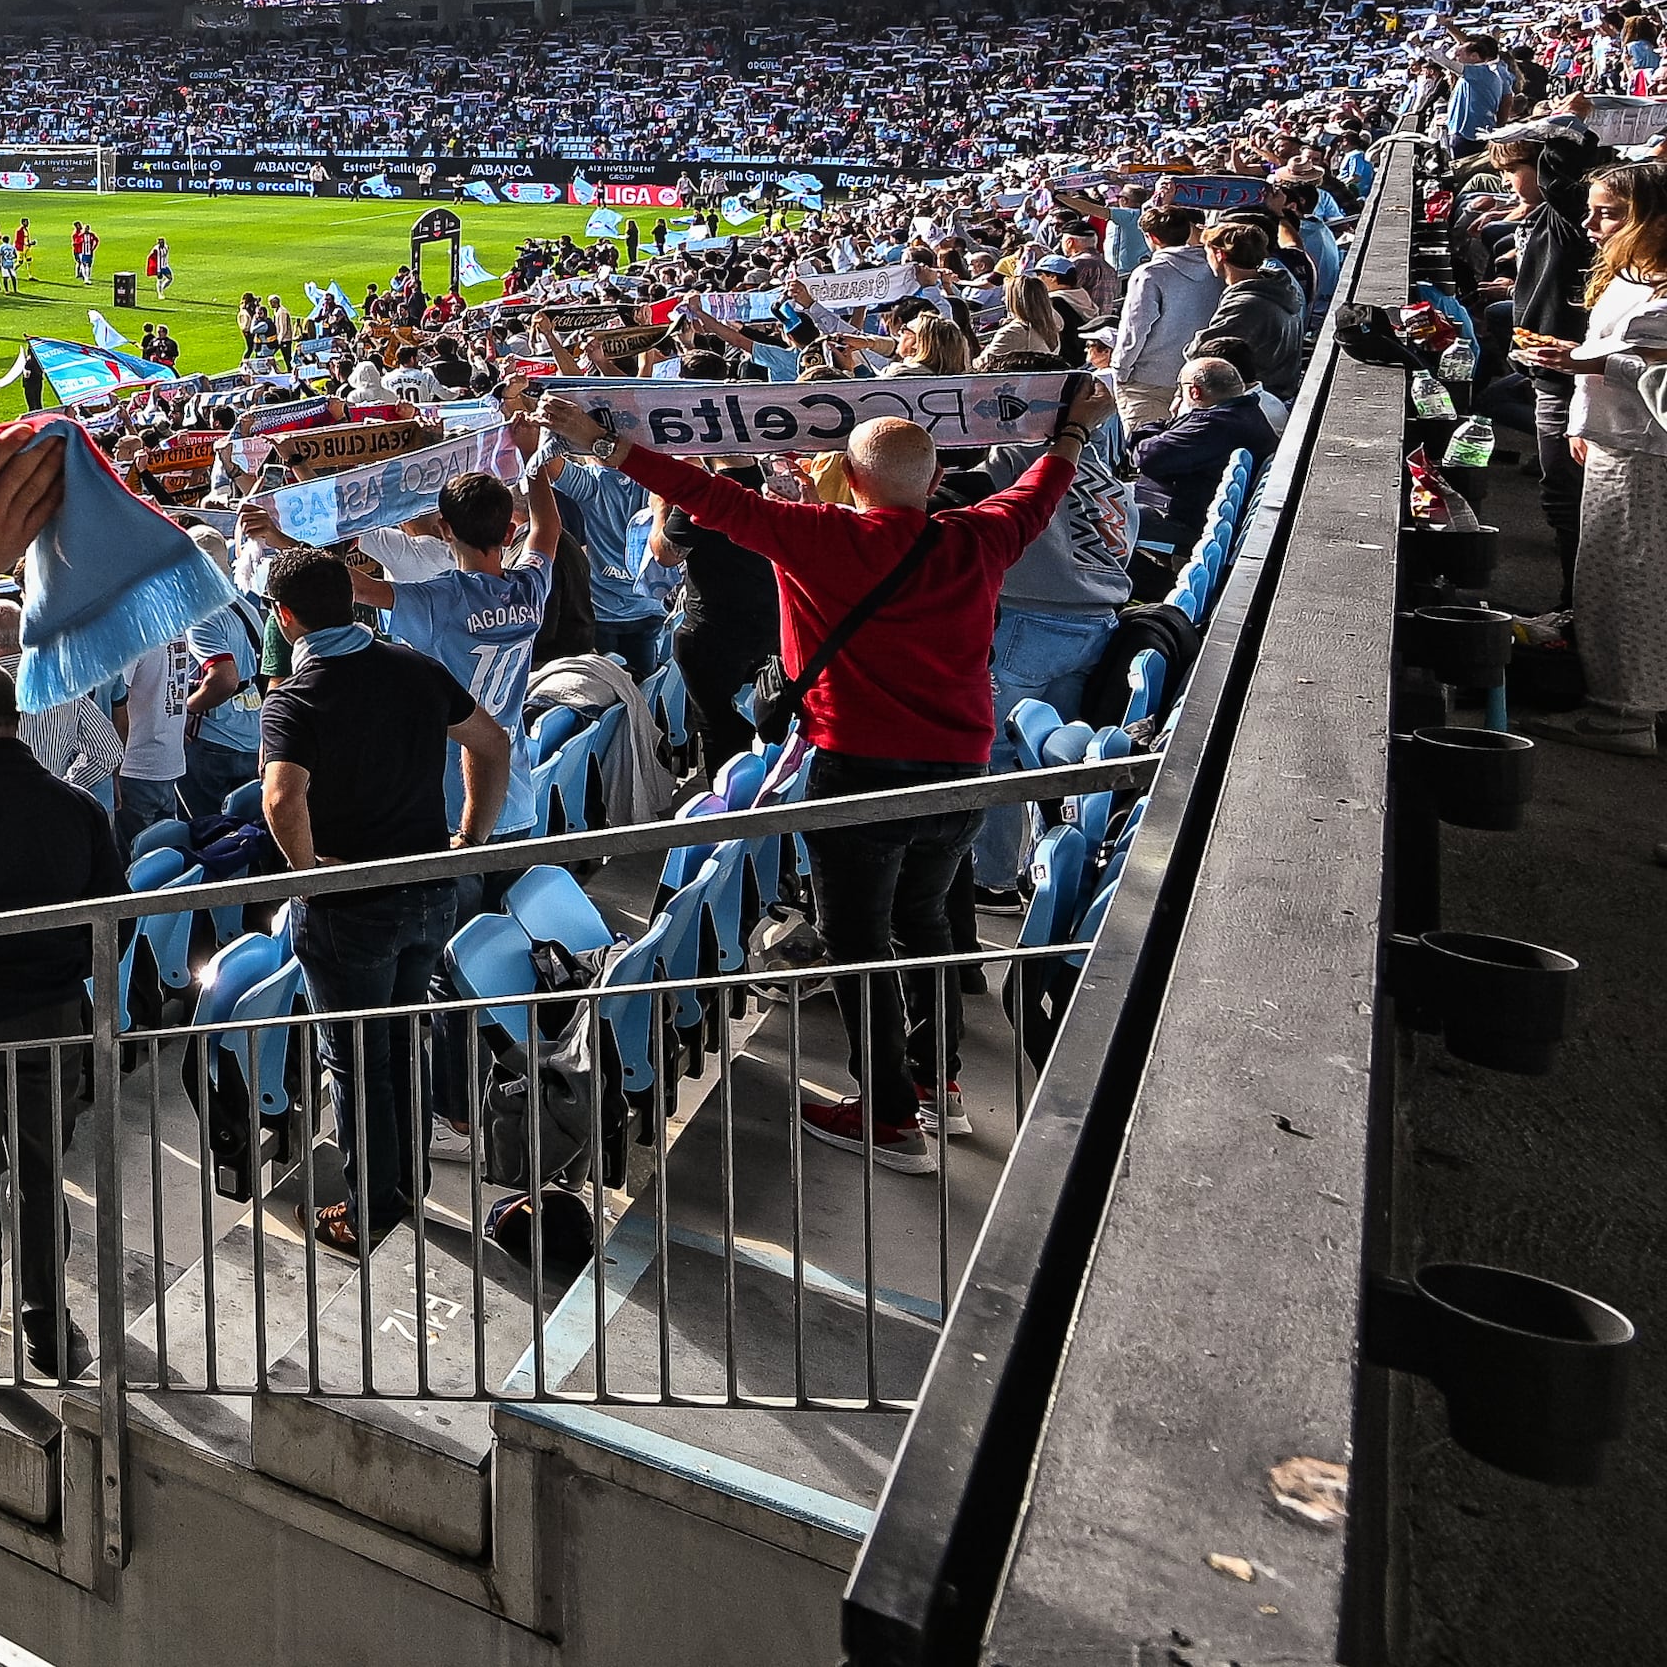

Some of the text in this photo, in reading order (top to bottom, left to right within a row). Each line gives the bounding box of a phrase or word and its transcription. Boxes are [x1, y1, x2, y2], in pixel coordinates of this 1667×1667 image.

[603, 165, 655, 173] INVESTMENT
[188, 178, 314, 193] FOLOW US @rccelta
[469, 639, 532, 717] 10
